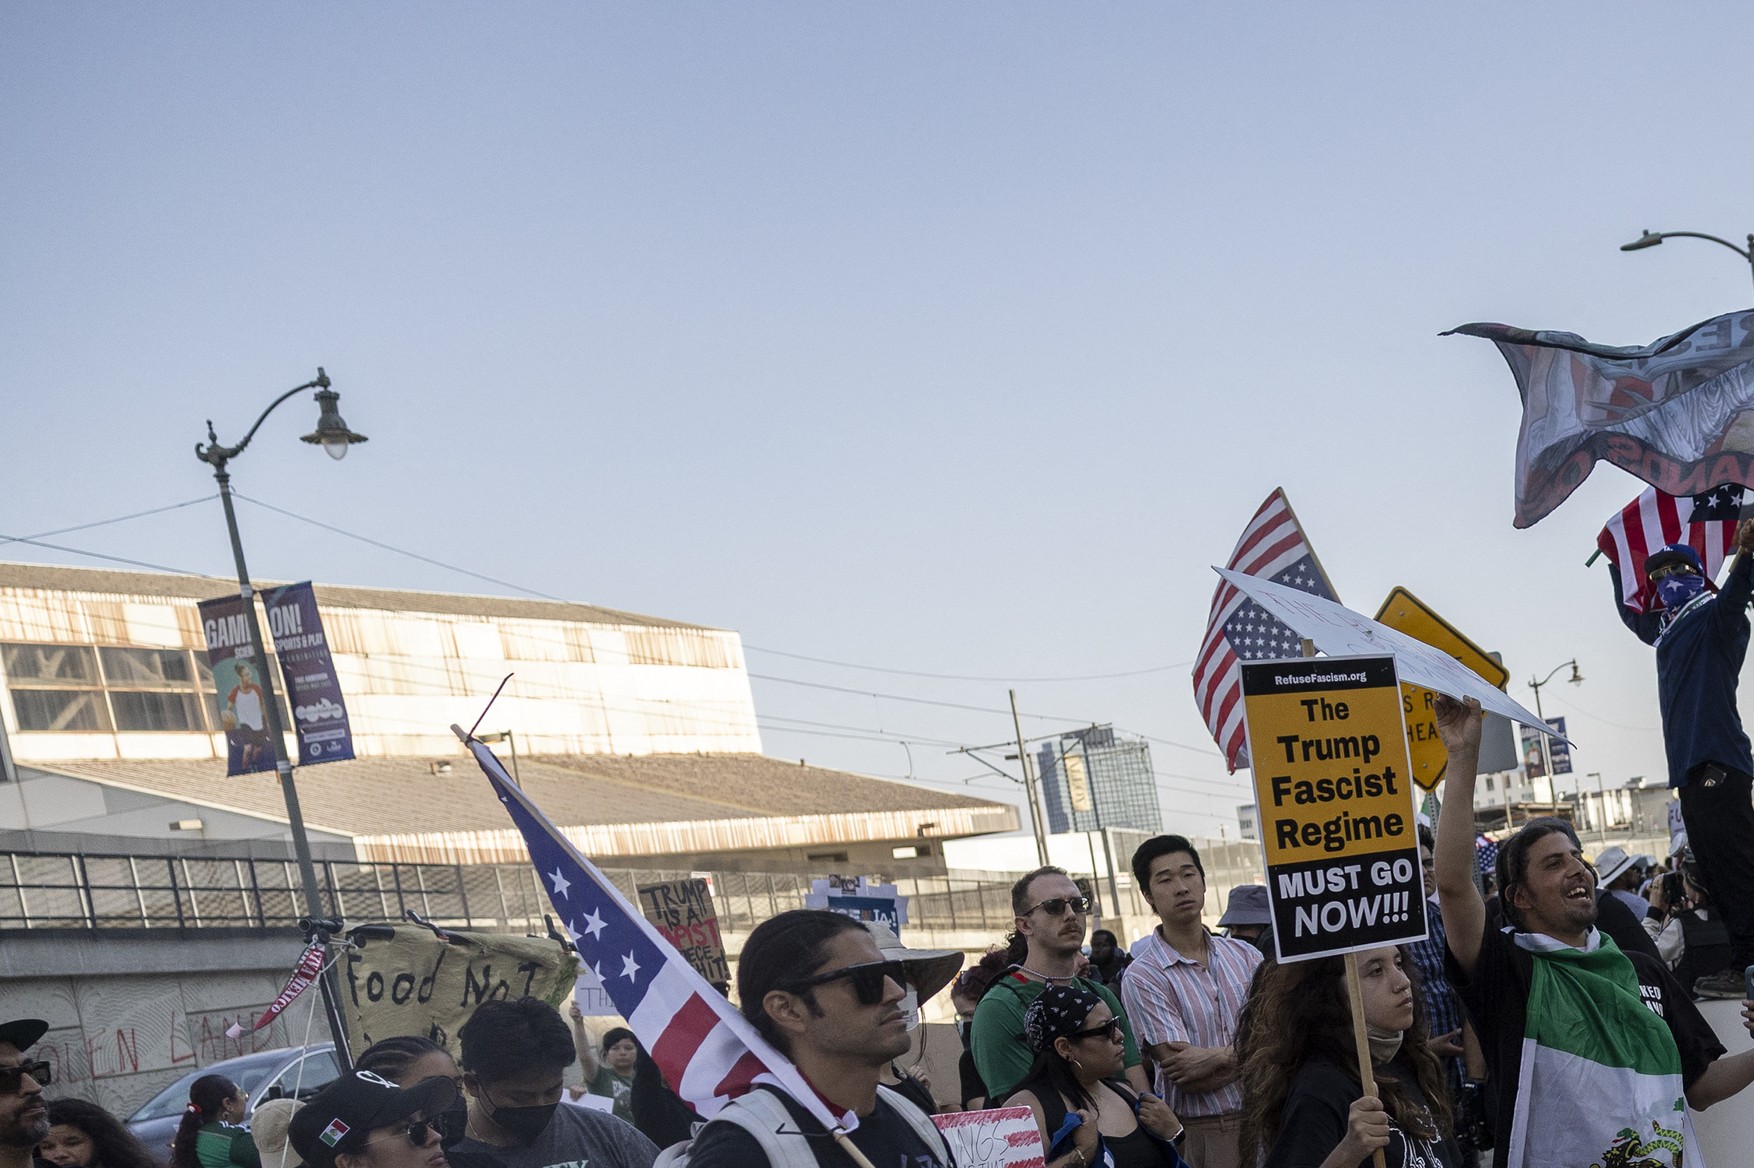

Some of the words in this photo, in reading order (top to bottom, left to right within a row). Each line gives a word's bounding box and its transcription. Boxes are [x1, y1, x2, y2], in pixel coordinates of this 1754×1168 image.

[269, 603, 303, 638] ON!
[234, 643, 255, 660] SCIE
[1275, 671, 1367, 686] RefuseFascism.org
[1300, 697, 1350, 722] The
[1277, 732, 1381, 764] Trump
[1407, 722, 1438, 742] HEA
[1271, 766, 1398, 807] Fascist
[1275, 811, 1404, 852] Regime
[1278, 865, 1362, 899] MUST
[1370, 858, 1413, 887] GO
[640, 879, 708, 919] TRUMP
[1295, 891, 1410, 938] NOW!!!
[656, 918, 719, 949] APIST
[663, 910, 680, 931] IS
[687, 905, 699, 927] A
[347, 949, 446, 1008] Food
[696, 951, 731, 979] HIT!
[36, 1028, 138, 1083] OLEN
